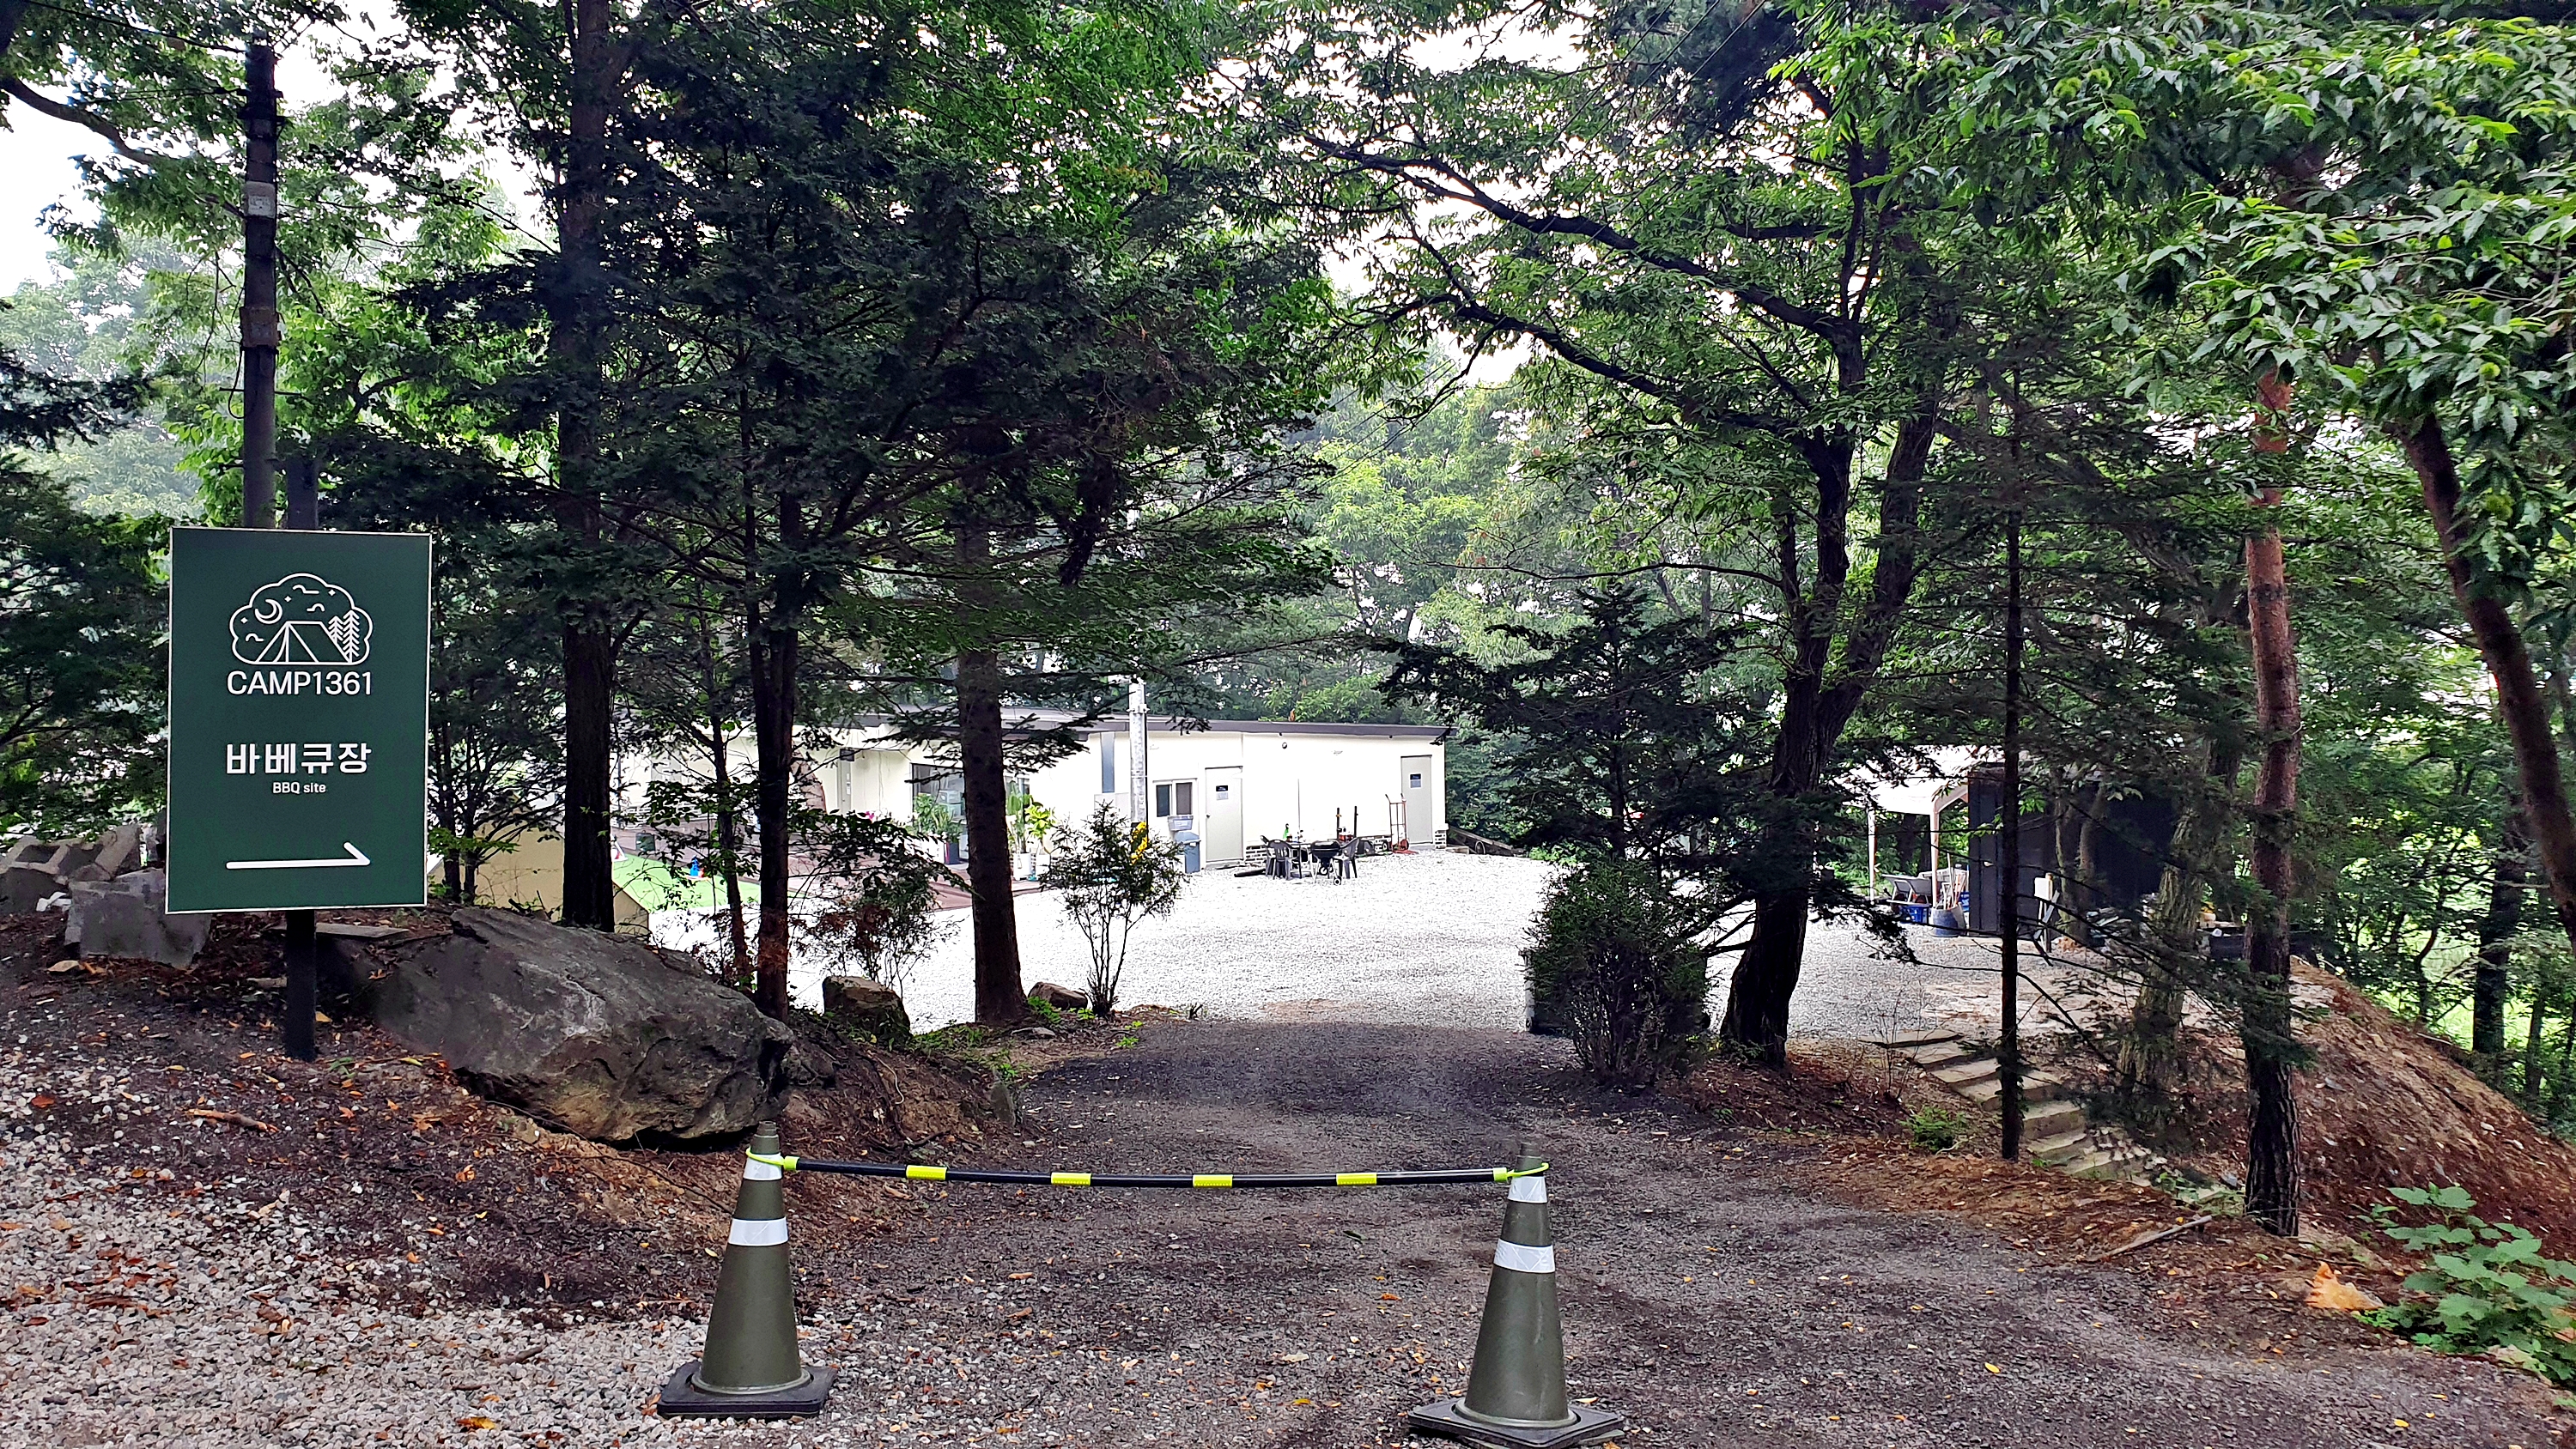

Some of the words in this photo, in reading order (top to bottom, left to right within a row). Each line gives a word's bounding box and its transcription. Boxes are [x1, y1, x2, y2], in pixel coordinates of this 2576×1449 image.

[227, 670, 371, 695] CAMP1361
[226, 743, 372, 774] 바베큐장
[272, 781, 301, 794] BBQ
[303, 782, 326, 793] site
